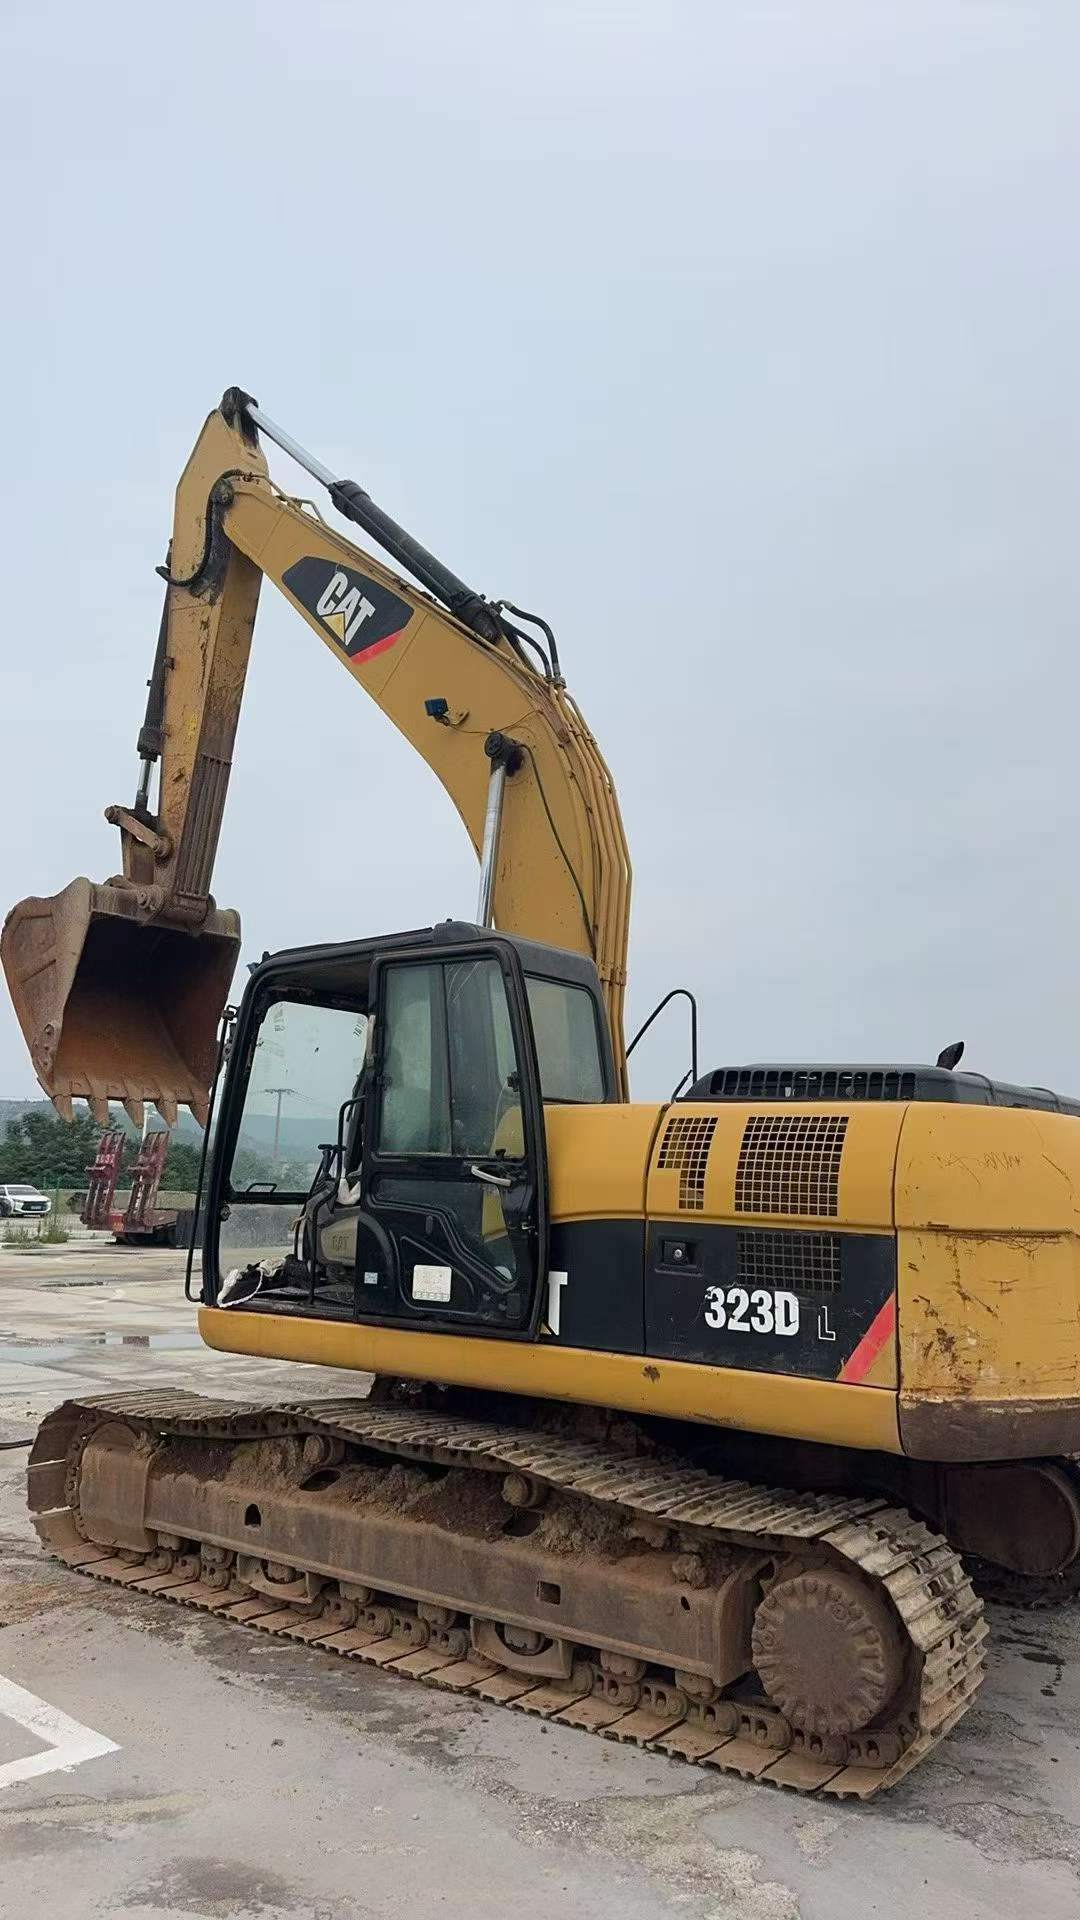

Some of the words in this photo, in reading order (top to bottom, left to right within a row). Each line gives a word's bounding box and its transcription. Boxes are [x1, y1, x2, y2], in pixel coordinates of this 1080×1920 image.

[316, 572, 376, 646] CAT
[705, 1286, 800, 1335] 323D
[818, 1306, 836, 1340] L
